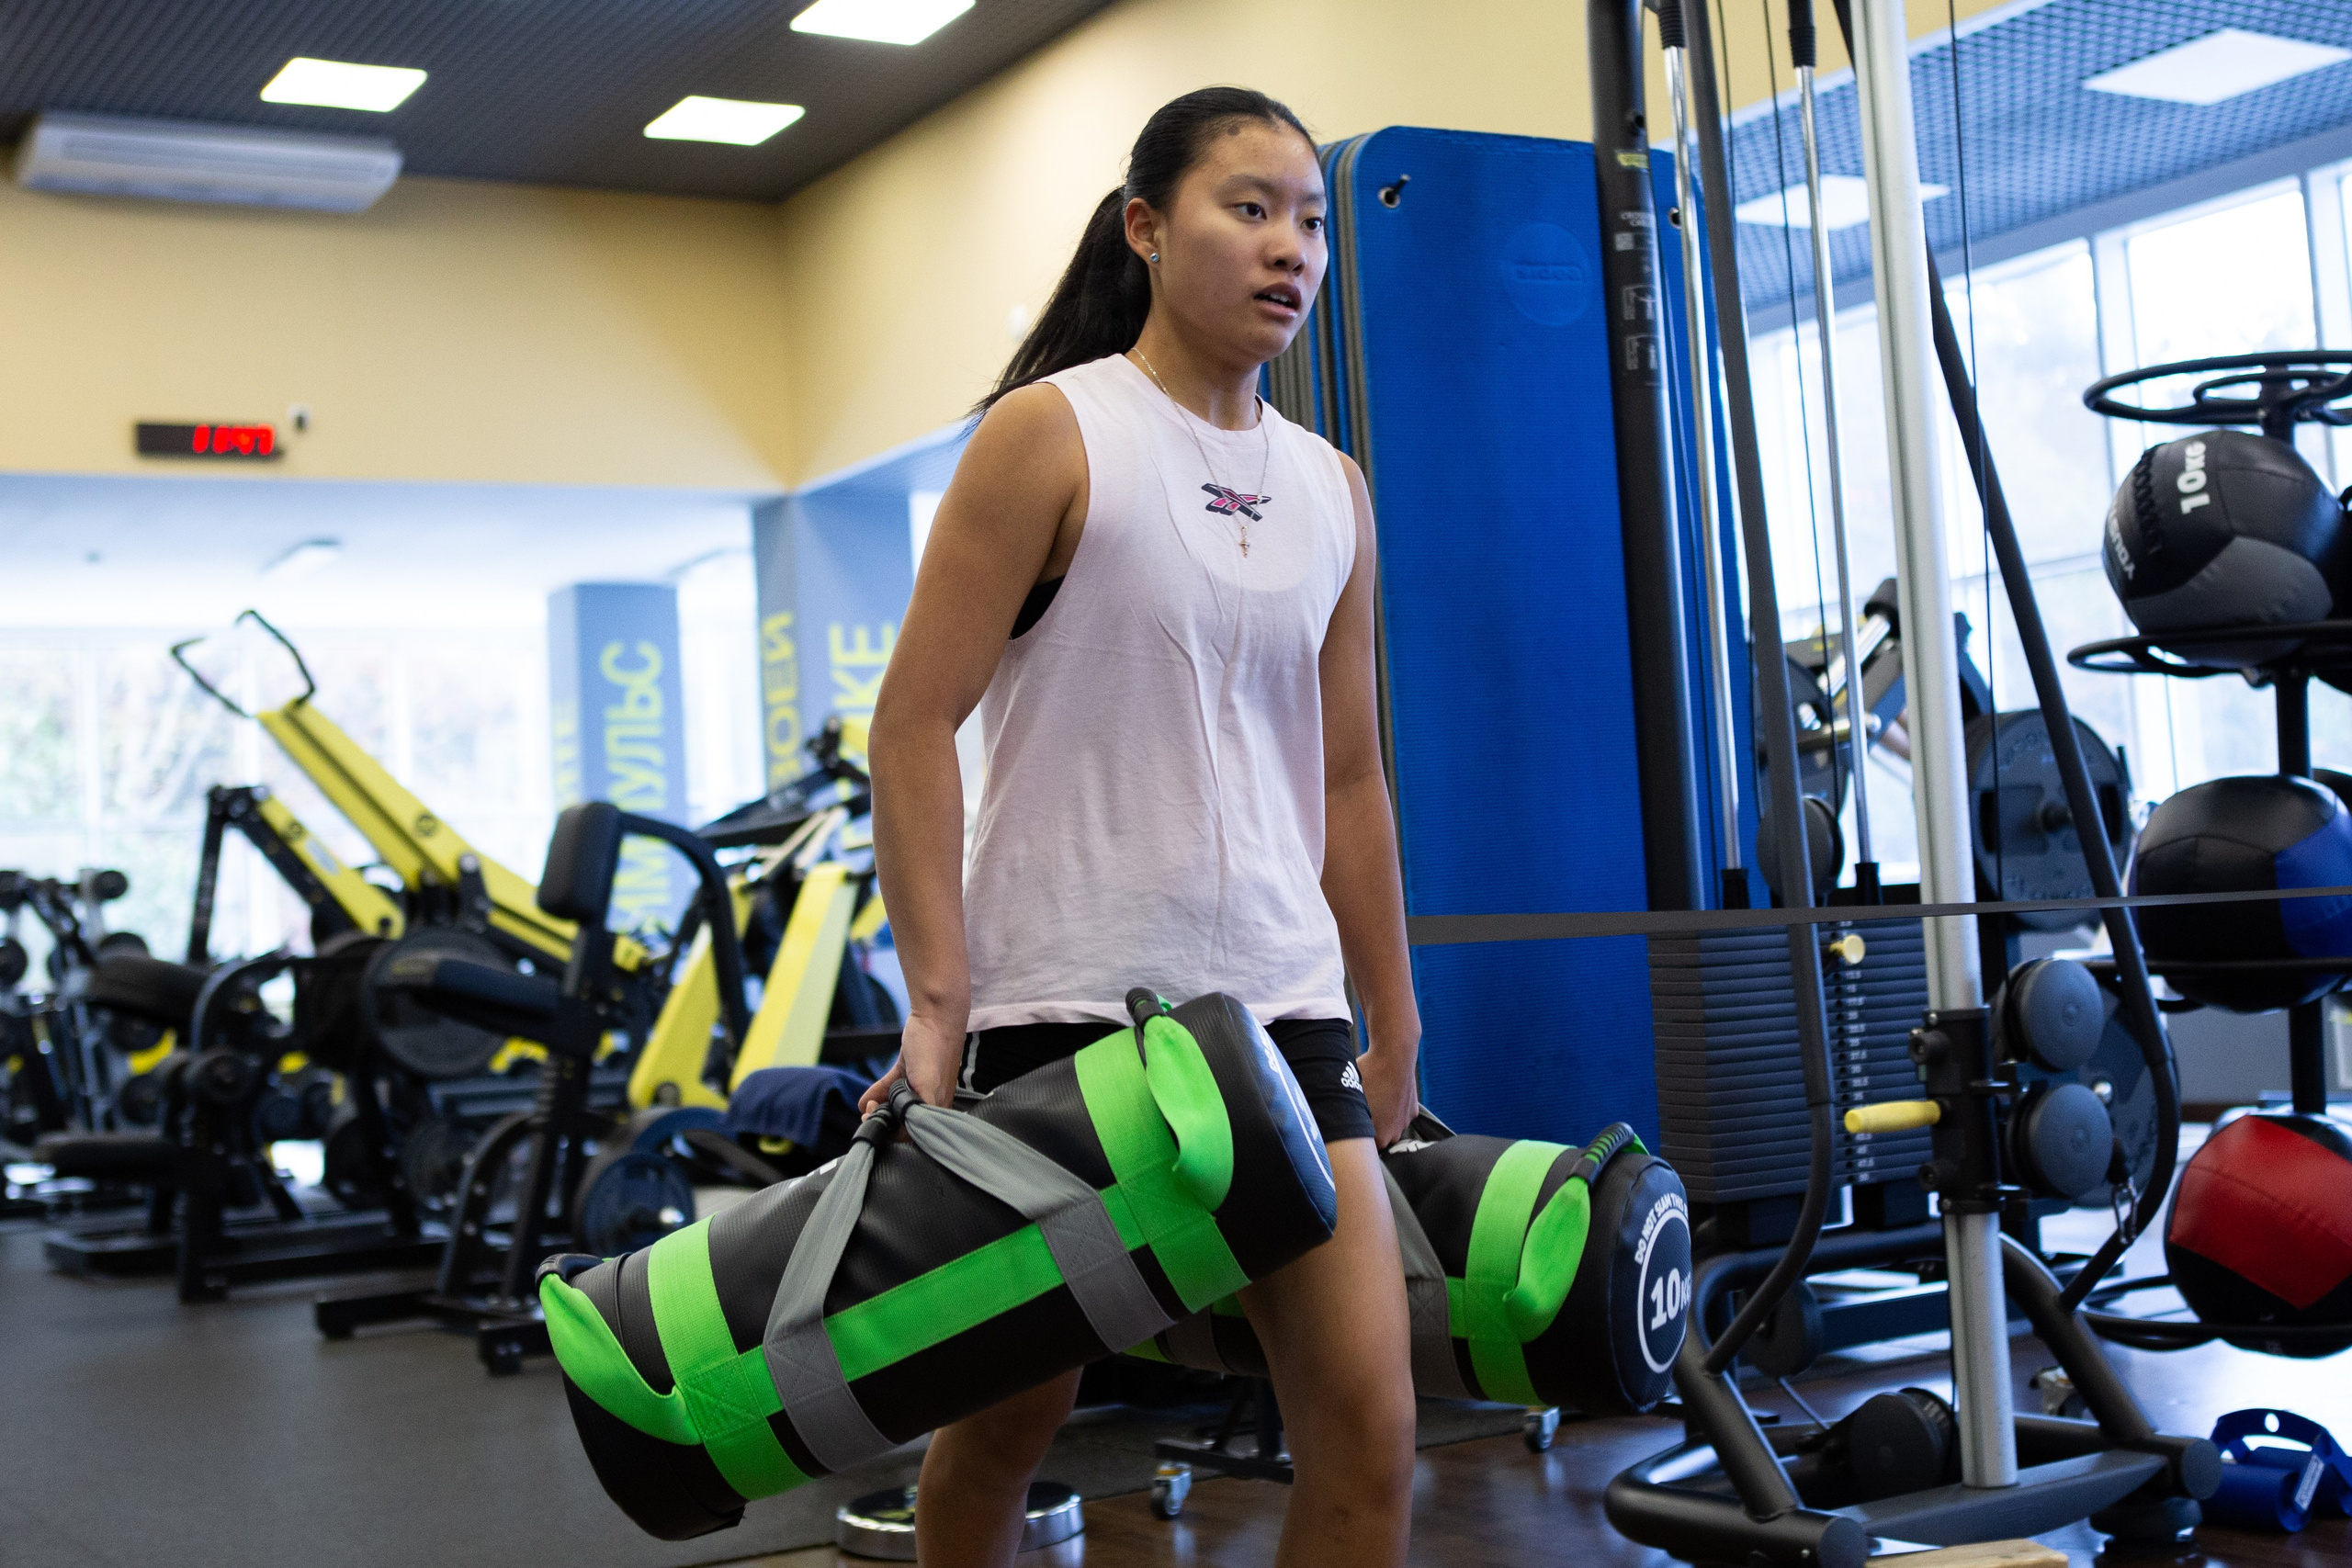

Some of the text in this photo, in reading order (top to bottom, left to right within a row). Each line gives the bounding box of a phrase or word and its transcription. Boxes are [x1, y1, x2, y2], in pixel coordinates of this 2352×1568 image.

[2177, 441, 2211, 514] 10KG
[1634, 1238, 1646, 1265] DO
[1641, 1208, 1657, 1242] NOT
[1654, 1193, 1673, 1218] SLAM
